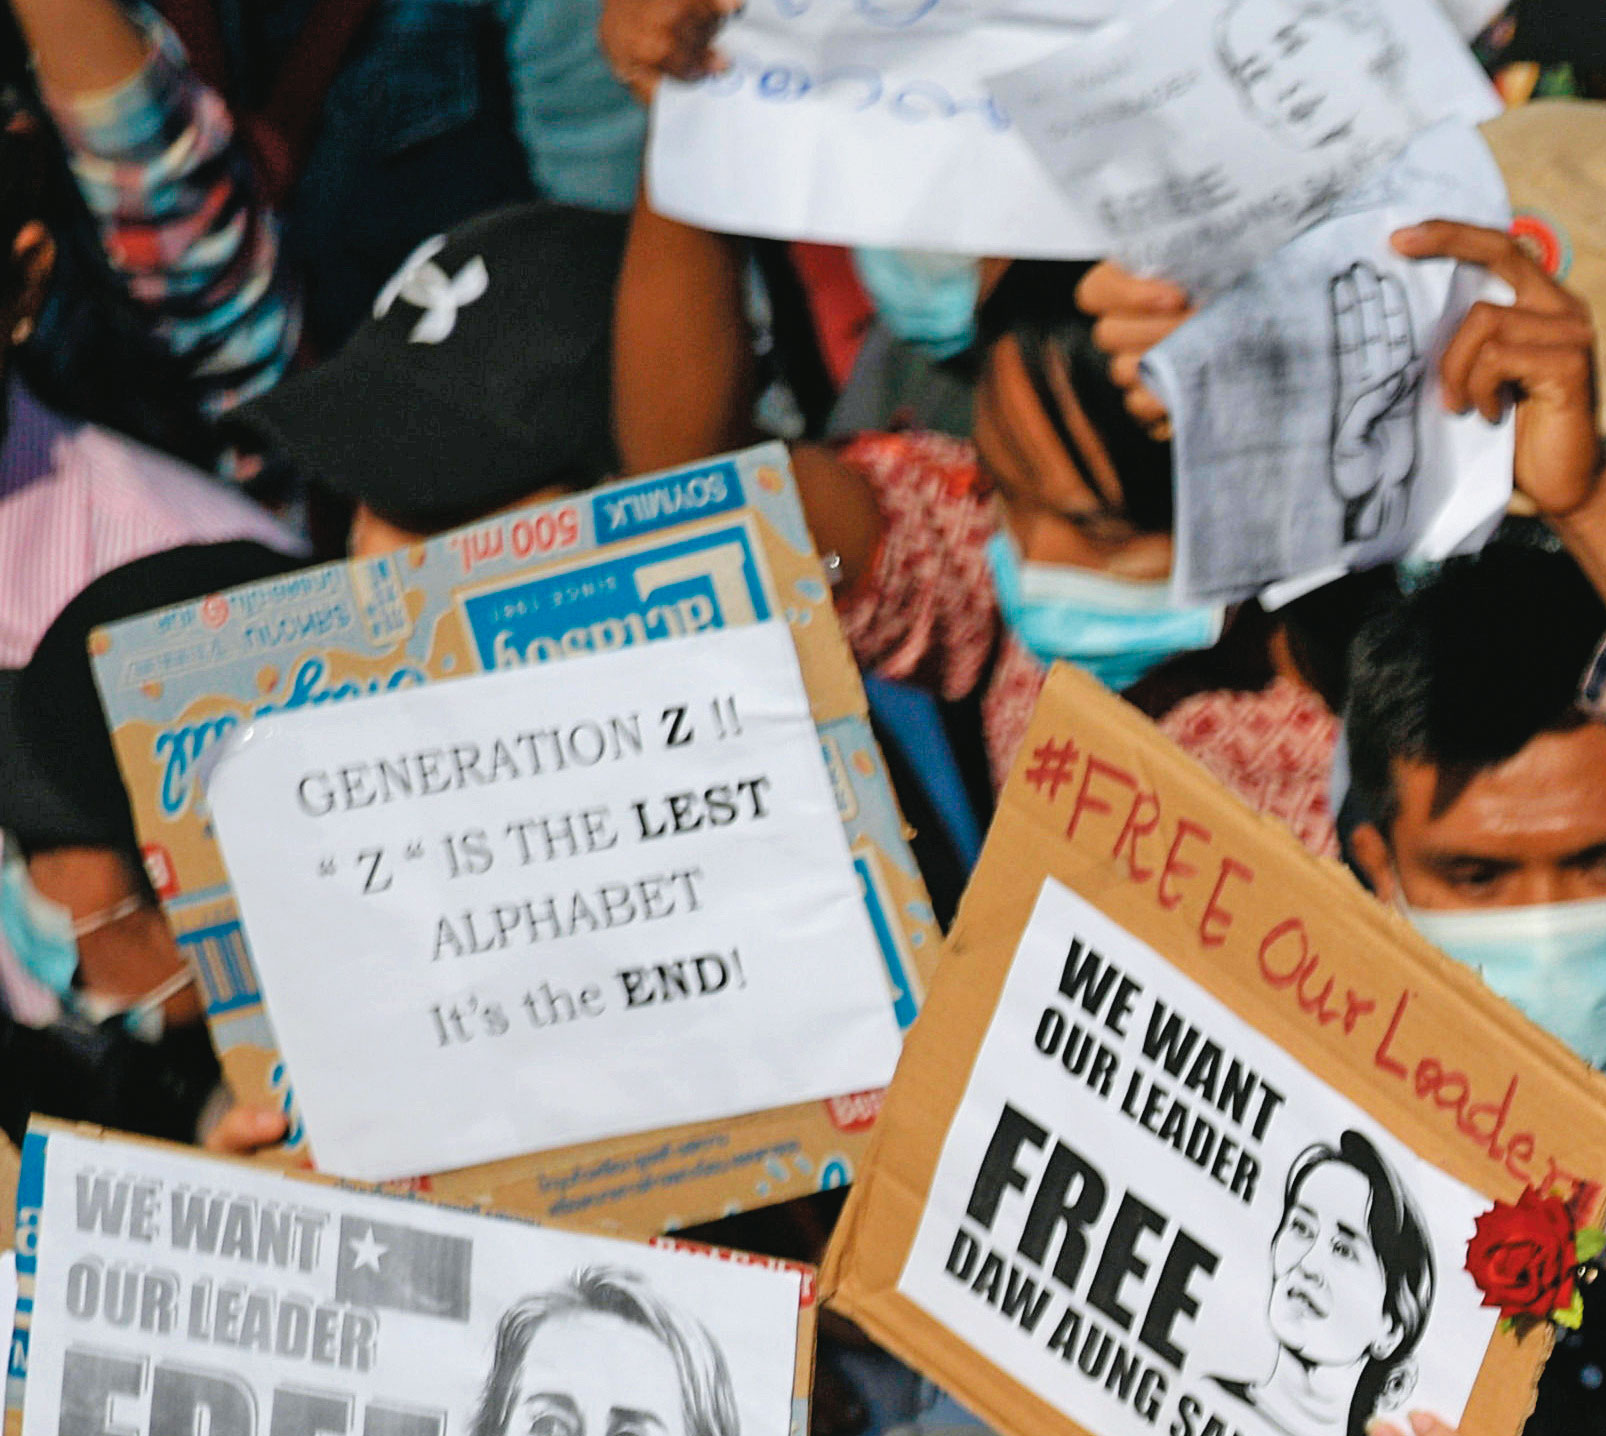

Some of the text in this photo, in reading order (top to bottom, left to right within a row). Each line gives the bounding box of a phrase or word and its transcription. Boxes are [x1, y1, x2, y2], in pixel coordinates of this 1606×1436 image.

[510, 508, 580, 554] 500
[603, 472, 727, 531] SOYMILK
[297, 695, 743, 817] GENERATION Z !!
[444, 832, 494, 881] IS
[506, 810, 620, 872] THE
[632, 777, 774, 840] LEST
[430, 869, 706, 961] ALPHABET
[1025, 737, 1255, 947] #FREE
[1257, 918, 1363, 1039] Our
[520, 980, 609, 1032] the
[617, 949, 747, 1013] END!
[1058, 936, 1286, 1143] WE WANT
[1034, 1006, 1262, 1203] OUR LEADER
[74, 1168, 163, 1242] WE
[170, 1182, 331, 1273] WANT
[965, 1099, 1223, 1369] FREE
[65, 1256, 381, 1372] OUR LEADER
[945, 1228, 1053, 1335] DAW
[1048, 1305, 1174, 1426] AUNG
